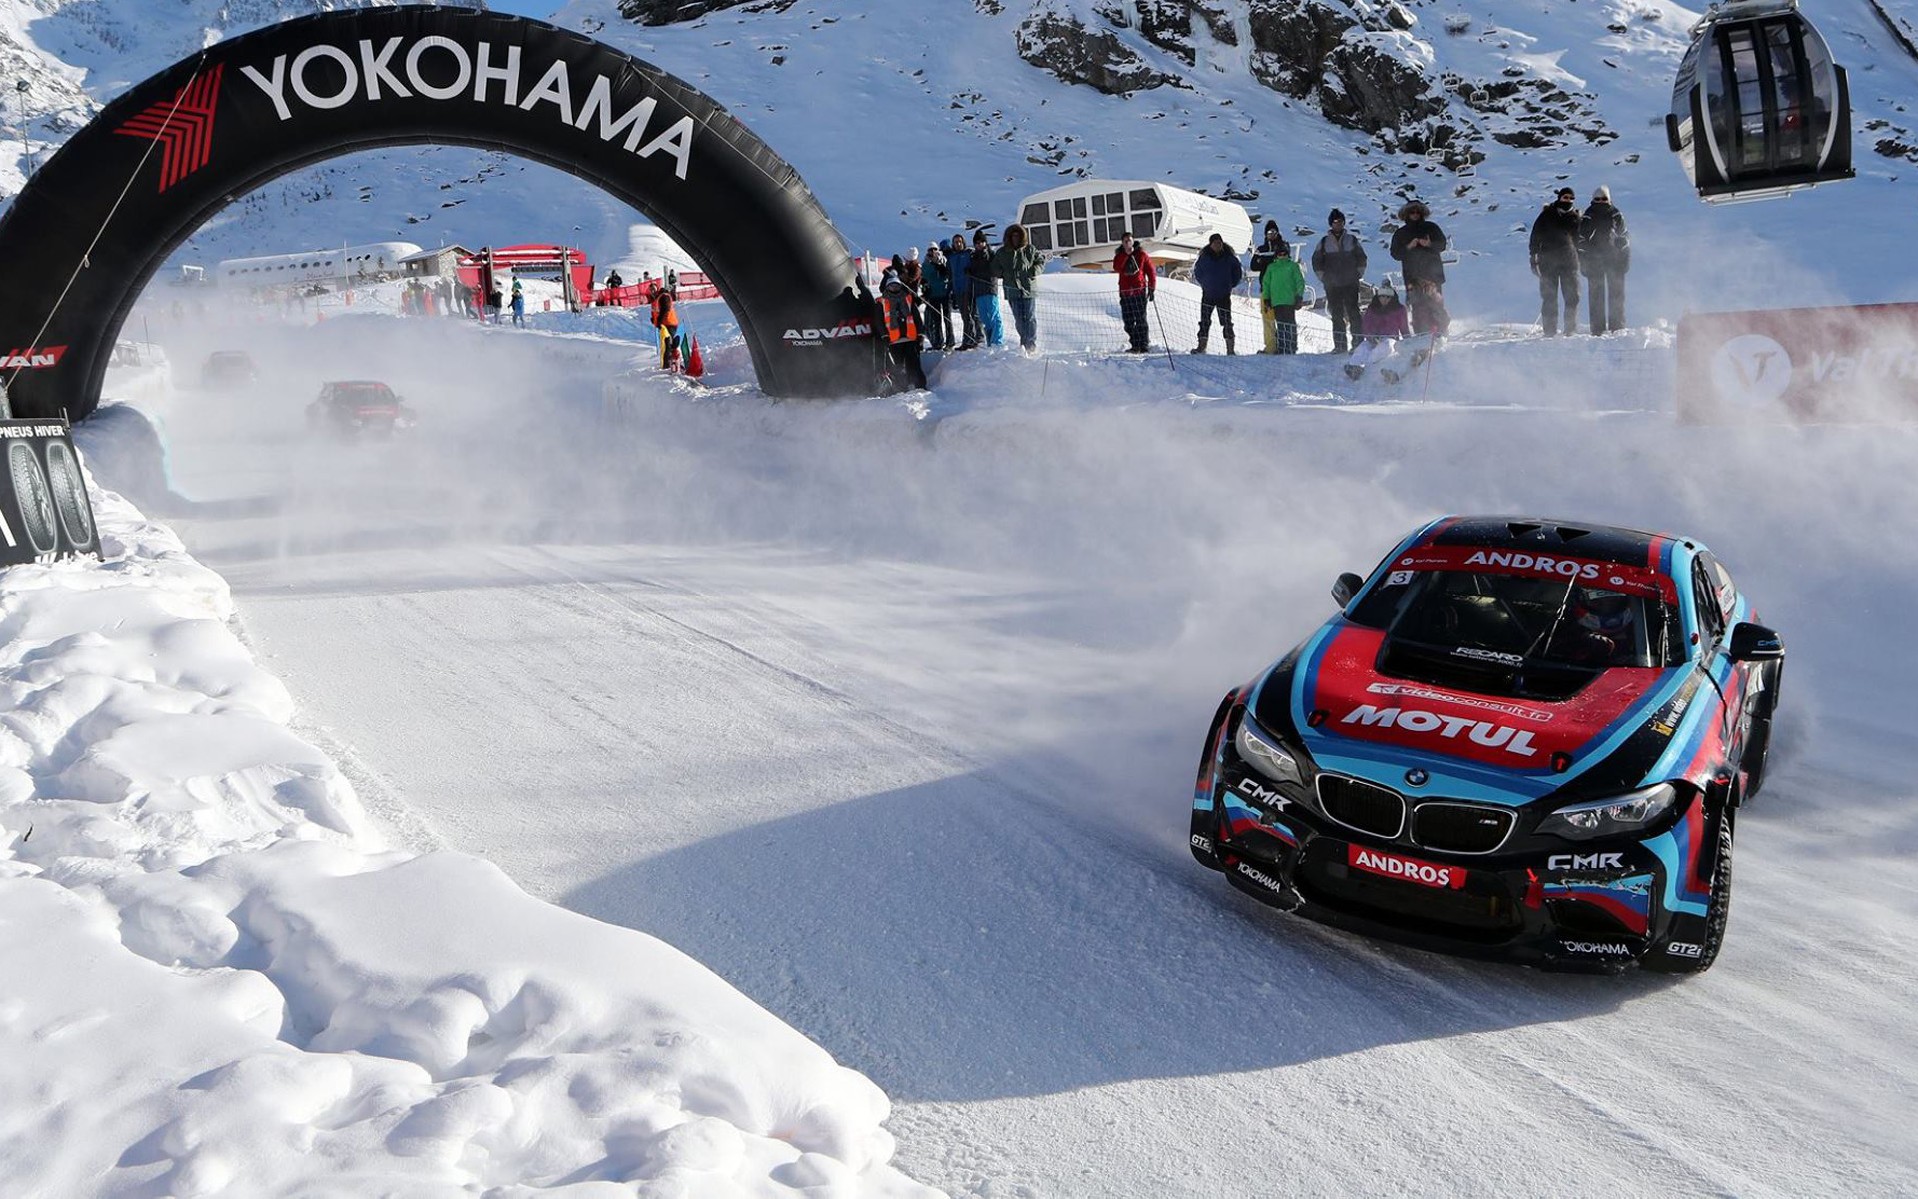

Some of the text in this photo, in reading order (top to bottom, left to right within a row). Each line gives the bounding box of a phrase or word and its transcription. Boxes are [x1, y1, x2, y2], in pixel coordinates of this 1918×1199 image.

[239, 35, 694, 180] YOKOHAMA
[782, 324, 872, 339] ADVAN
[0, 425, 65, 438] PNEUS HIVER
[1393, 572, 1408, 583] 3
[1463, 551, 1600, 579] ANDROS
[1456, 647, 1523, 661] RECARO
[1399, 687, 1548, 720] videoconsult.fr
[1341, 704, 1537, 757] MOTUL
[1238, 777, 1292, 812] CMR
[1356, 851, 1450, 886] ANDROS
[1547, 852, 1624, 870] CMR
[1237, 861, 1281, 893] YOKOHAMA
